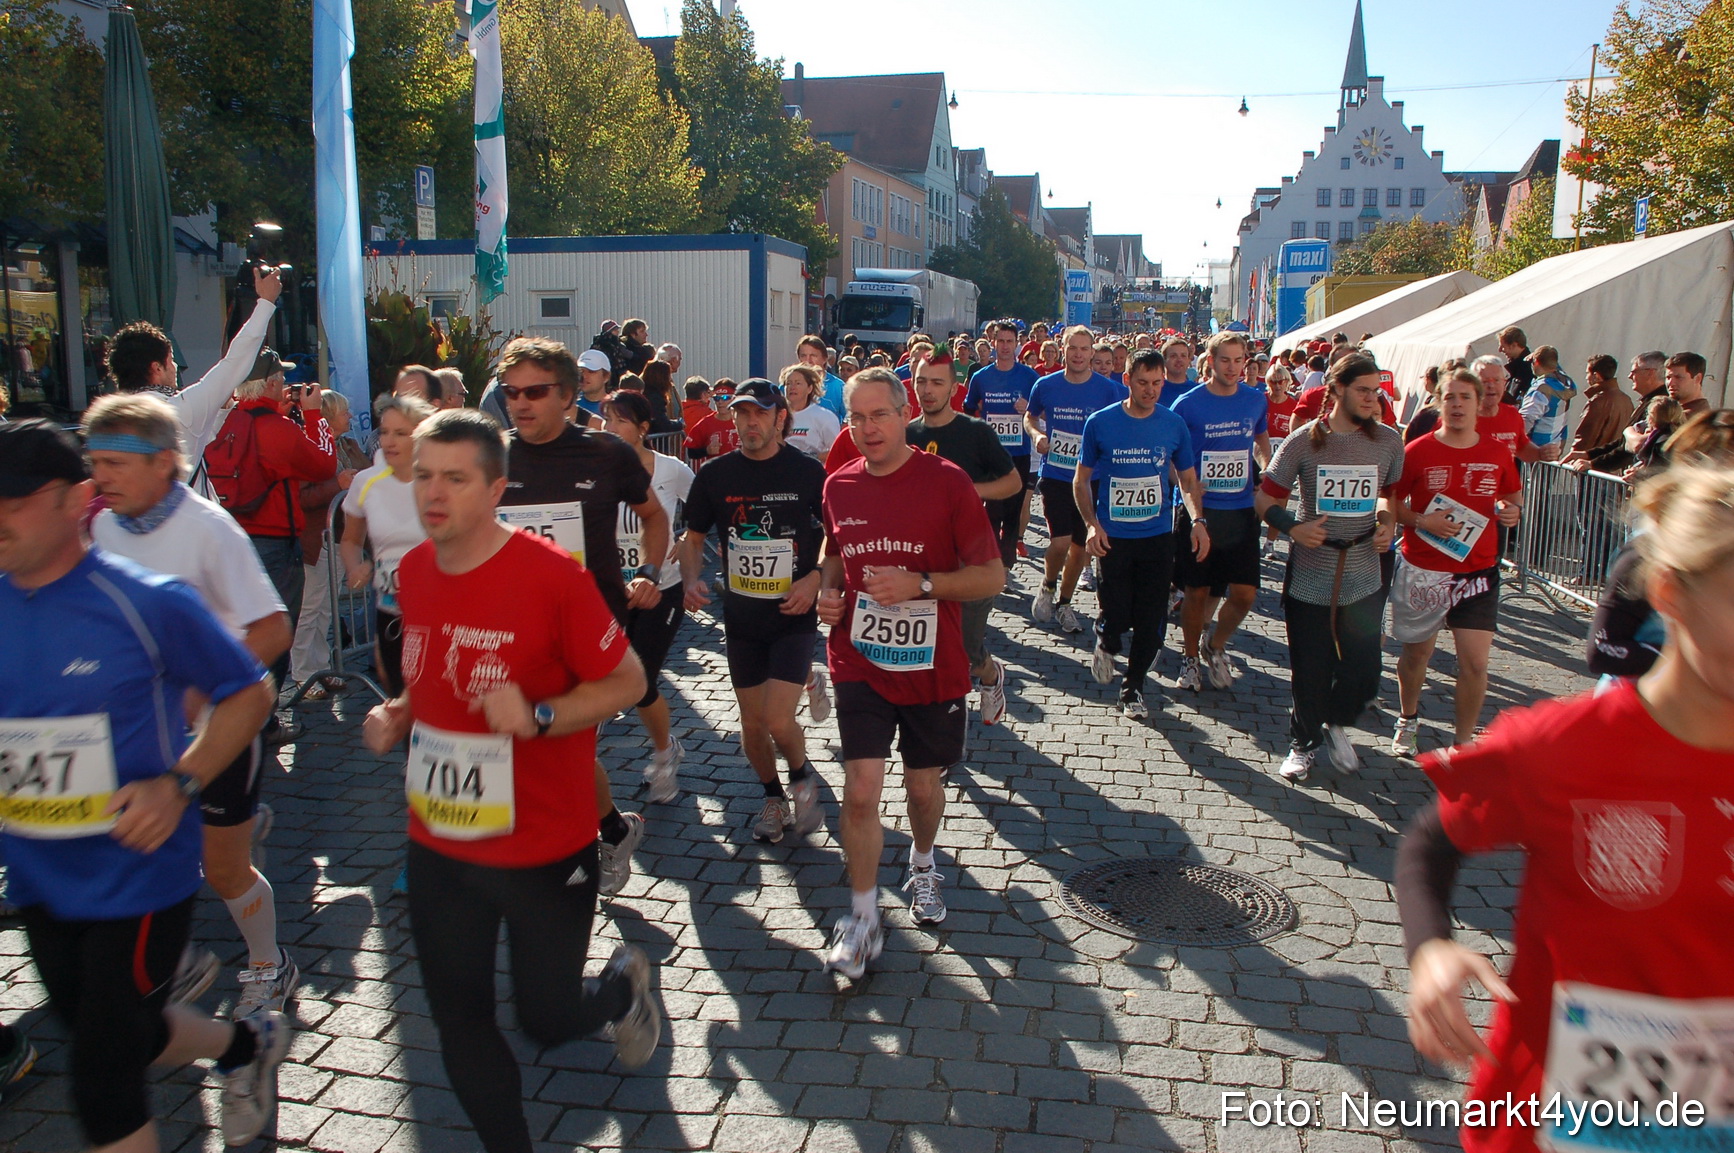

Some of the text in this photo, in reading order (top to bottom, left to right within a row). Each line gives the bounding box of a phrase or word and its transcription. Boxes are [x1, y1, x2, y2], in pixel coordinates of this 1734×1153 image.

[420, 171, 430, 200] P
[1637, 202, 1646, 229] P
[1289, 248, 1325, 267] maxi
[1069, 276, 1086, 288] axi
[1204, 421, 1240, 430] Kirwaläufer
[1204, 430, 1242, 438] Pettenhofen
[1053, 440, 1081, 457] 244
[1206, 462, 1244, 478] 3288
[1208, 478, 1241, 488] Michael
[1323, 479, 1371, 498] 2176
[1115, 488, 1156, 506] 2746
[1333, 500, 1361, 510] Peter
[1120, 506, 1152, 517] Johann
[842, 537, 925, 558] Gasthaus
[738, 555, 779, 577] 357
[739, 576, 781, 591] Werner
[861, 613, 928, 646] 2590
[859, 641, 926, 665] Wolfgang
[422, 753, 485, 802] 704
